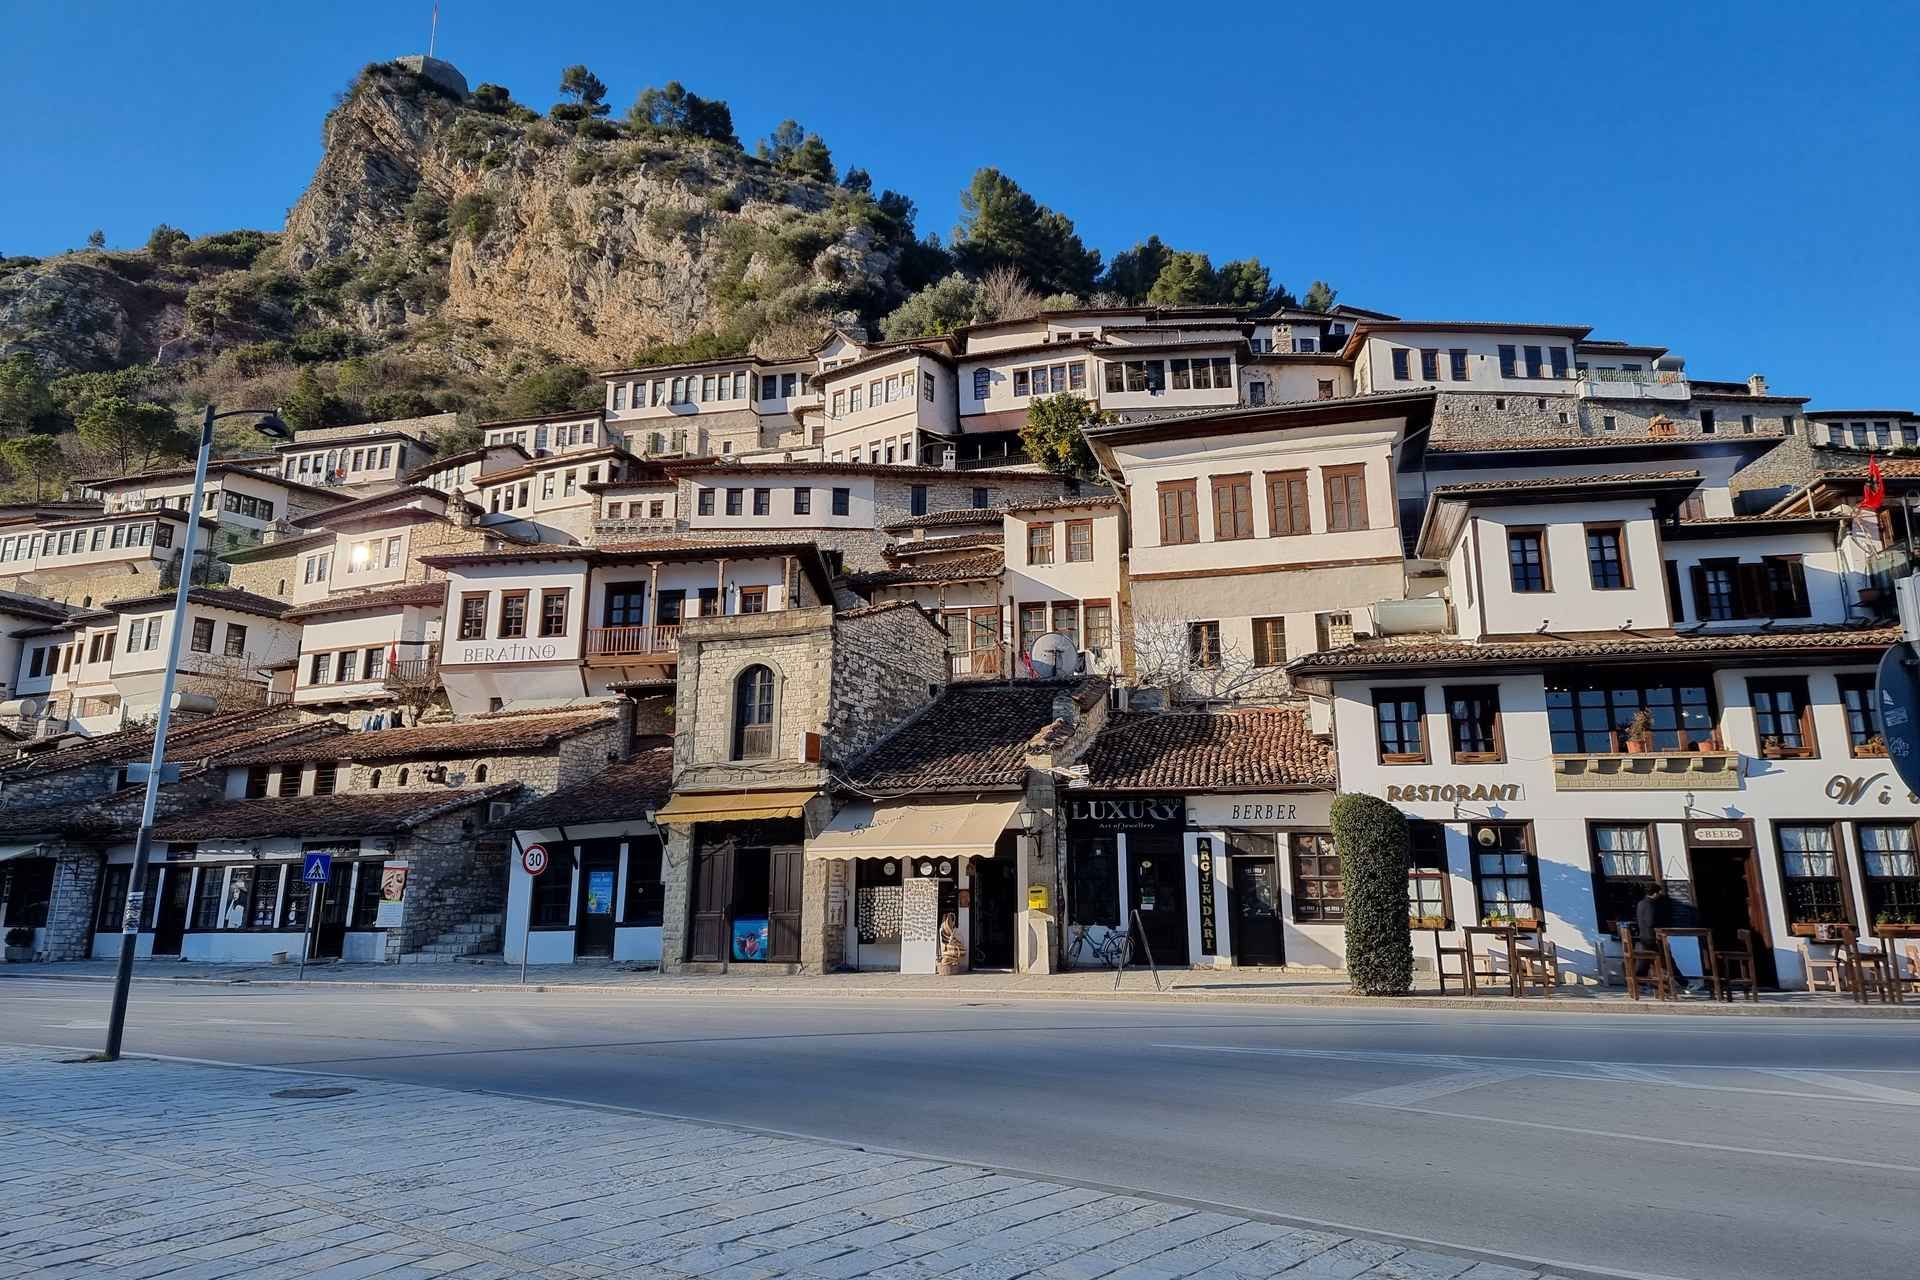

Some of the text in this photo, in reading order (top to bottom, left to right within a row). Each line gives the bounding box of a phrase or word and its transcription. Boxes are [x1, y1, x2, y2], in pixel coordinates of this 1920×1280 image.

[464, 643, 556, 662] BERATINO
[1386, 783, 1521, 801] RESTORANT
[1072, 799, 1179, 820] LUXURY
[1232, 804, 1297, 820] BERBER
[529, 853, 541, 866] 30
[1200, 840, 1214, 949] ARGJENDARI
